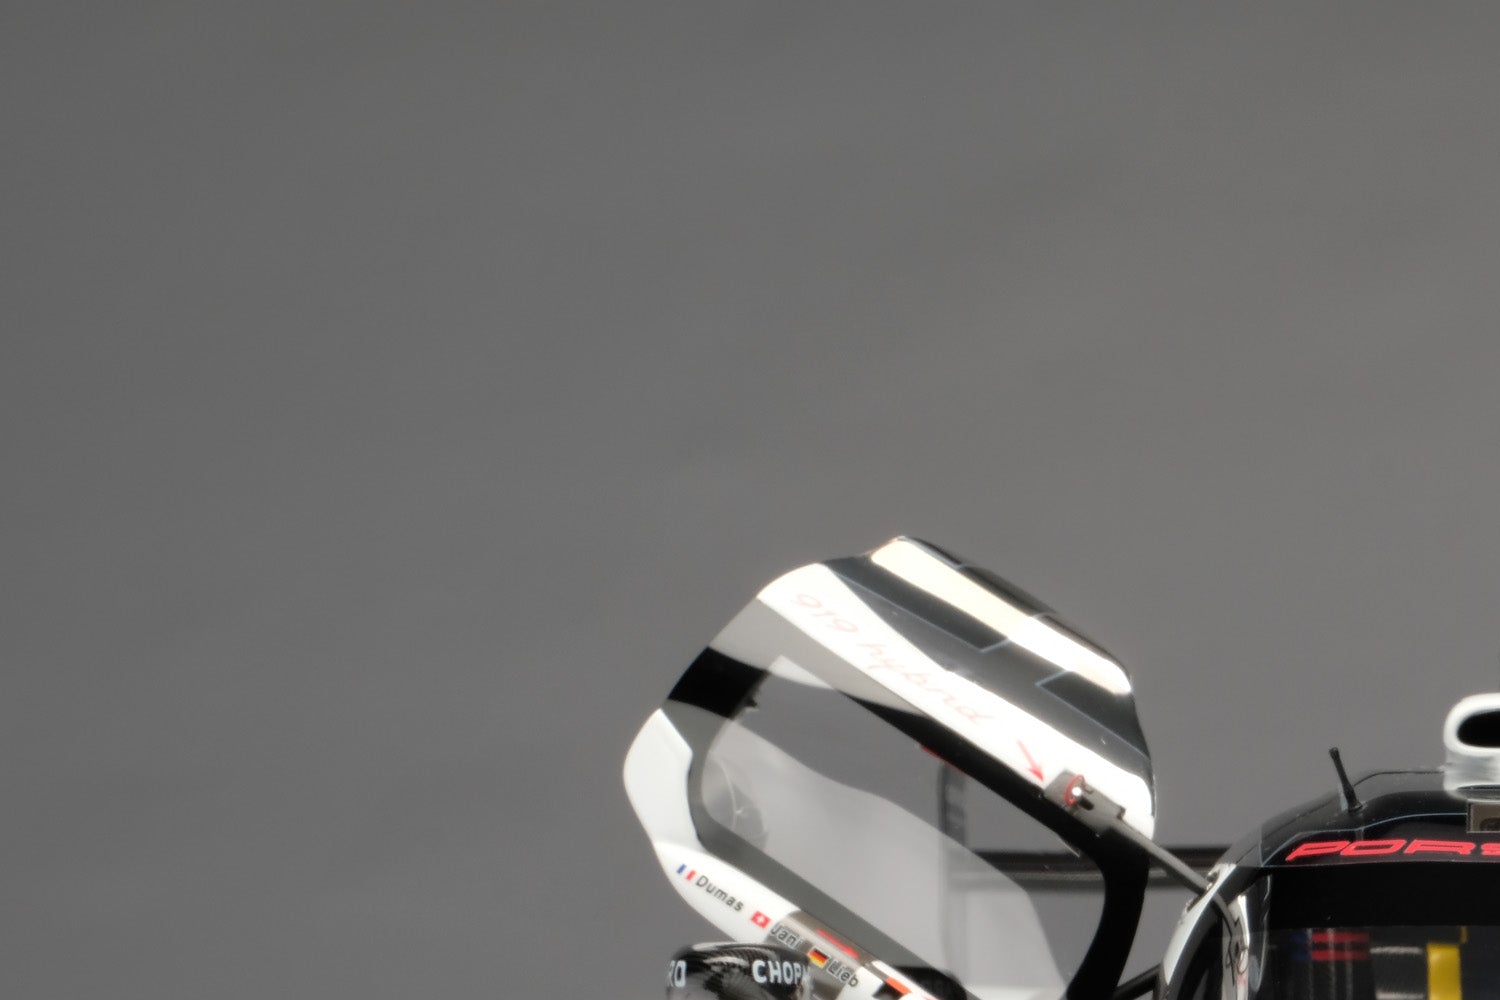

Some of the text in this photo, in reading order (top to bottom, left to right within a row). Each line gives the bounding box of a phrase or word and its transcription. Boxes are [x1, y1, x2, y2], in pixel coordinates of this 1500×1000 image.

[695, 875, 745, 912] Dumas
[770, 923, 804, 949] Jani
[827, 959, 859, 988] Lieb
